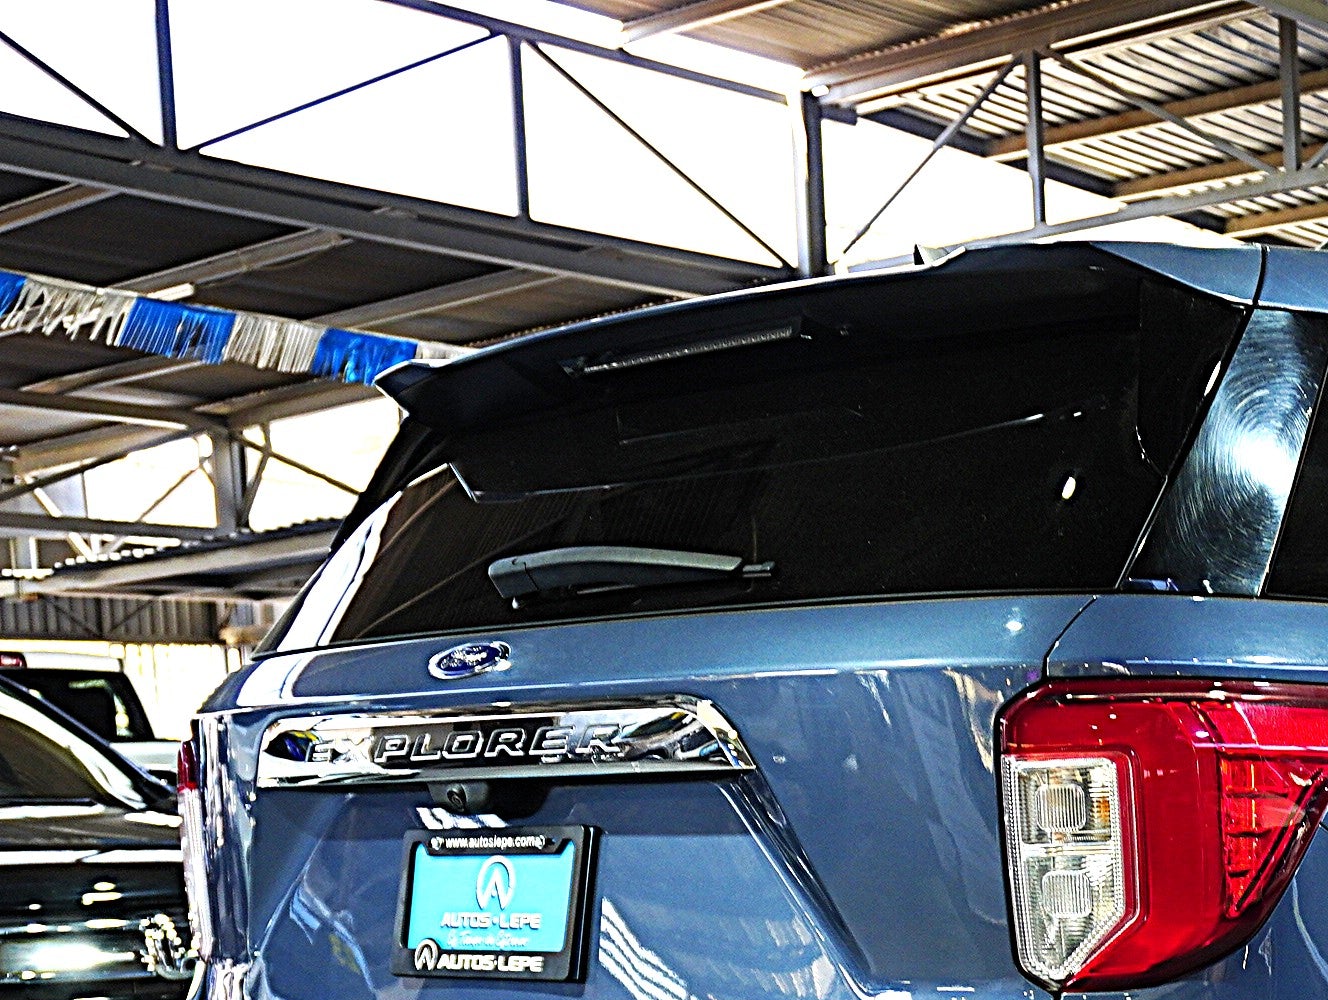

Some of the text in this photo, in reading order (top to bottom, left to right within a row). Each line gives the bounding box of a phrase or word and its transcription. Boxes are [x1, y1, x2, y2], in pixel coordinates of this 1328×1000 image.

[307, 724, 622, 764] EXPLORER
[440, 911, 541, 930] AUTOS LEPE
[437, 953, 544, 973] AUTOS LEPE
